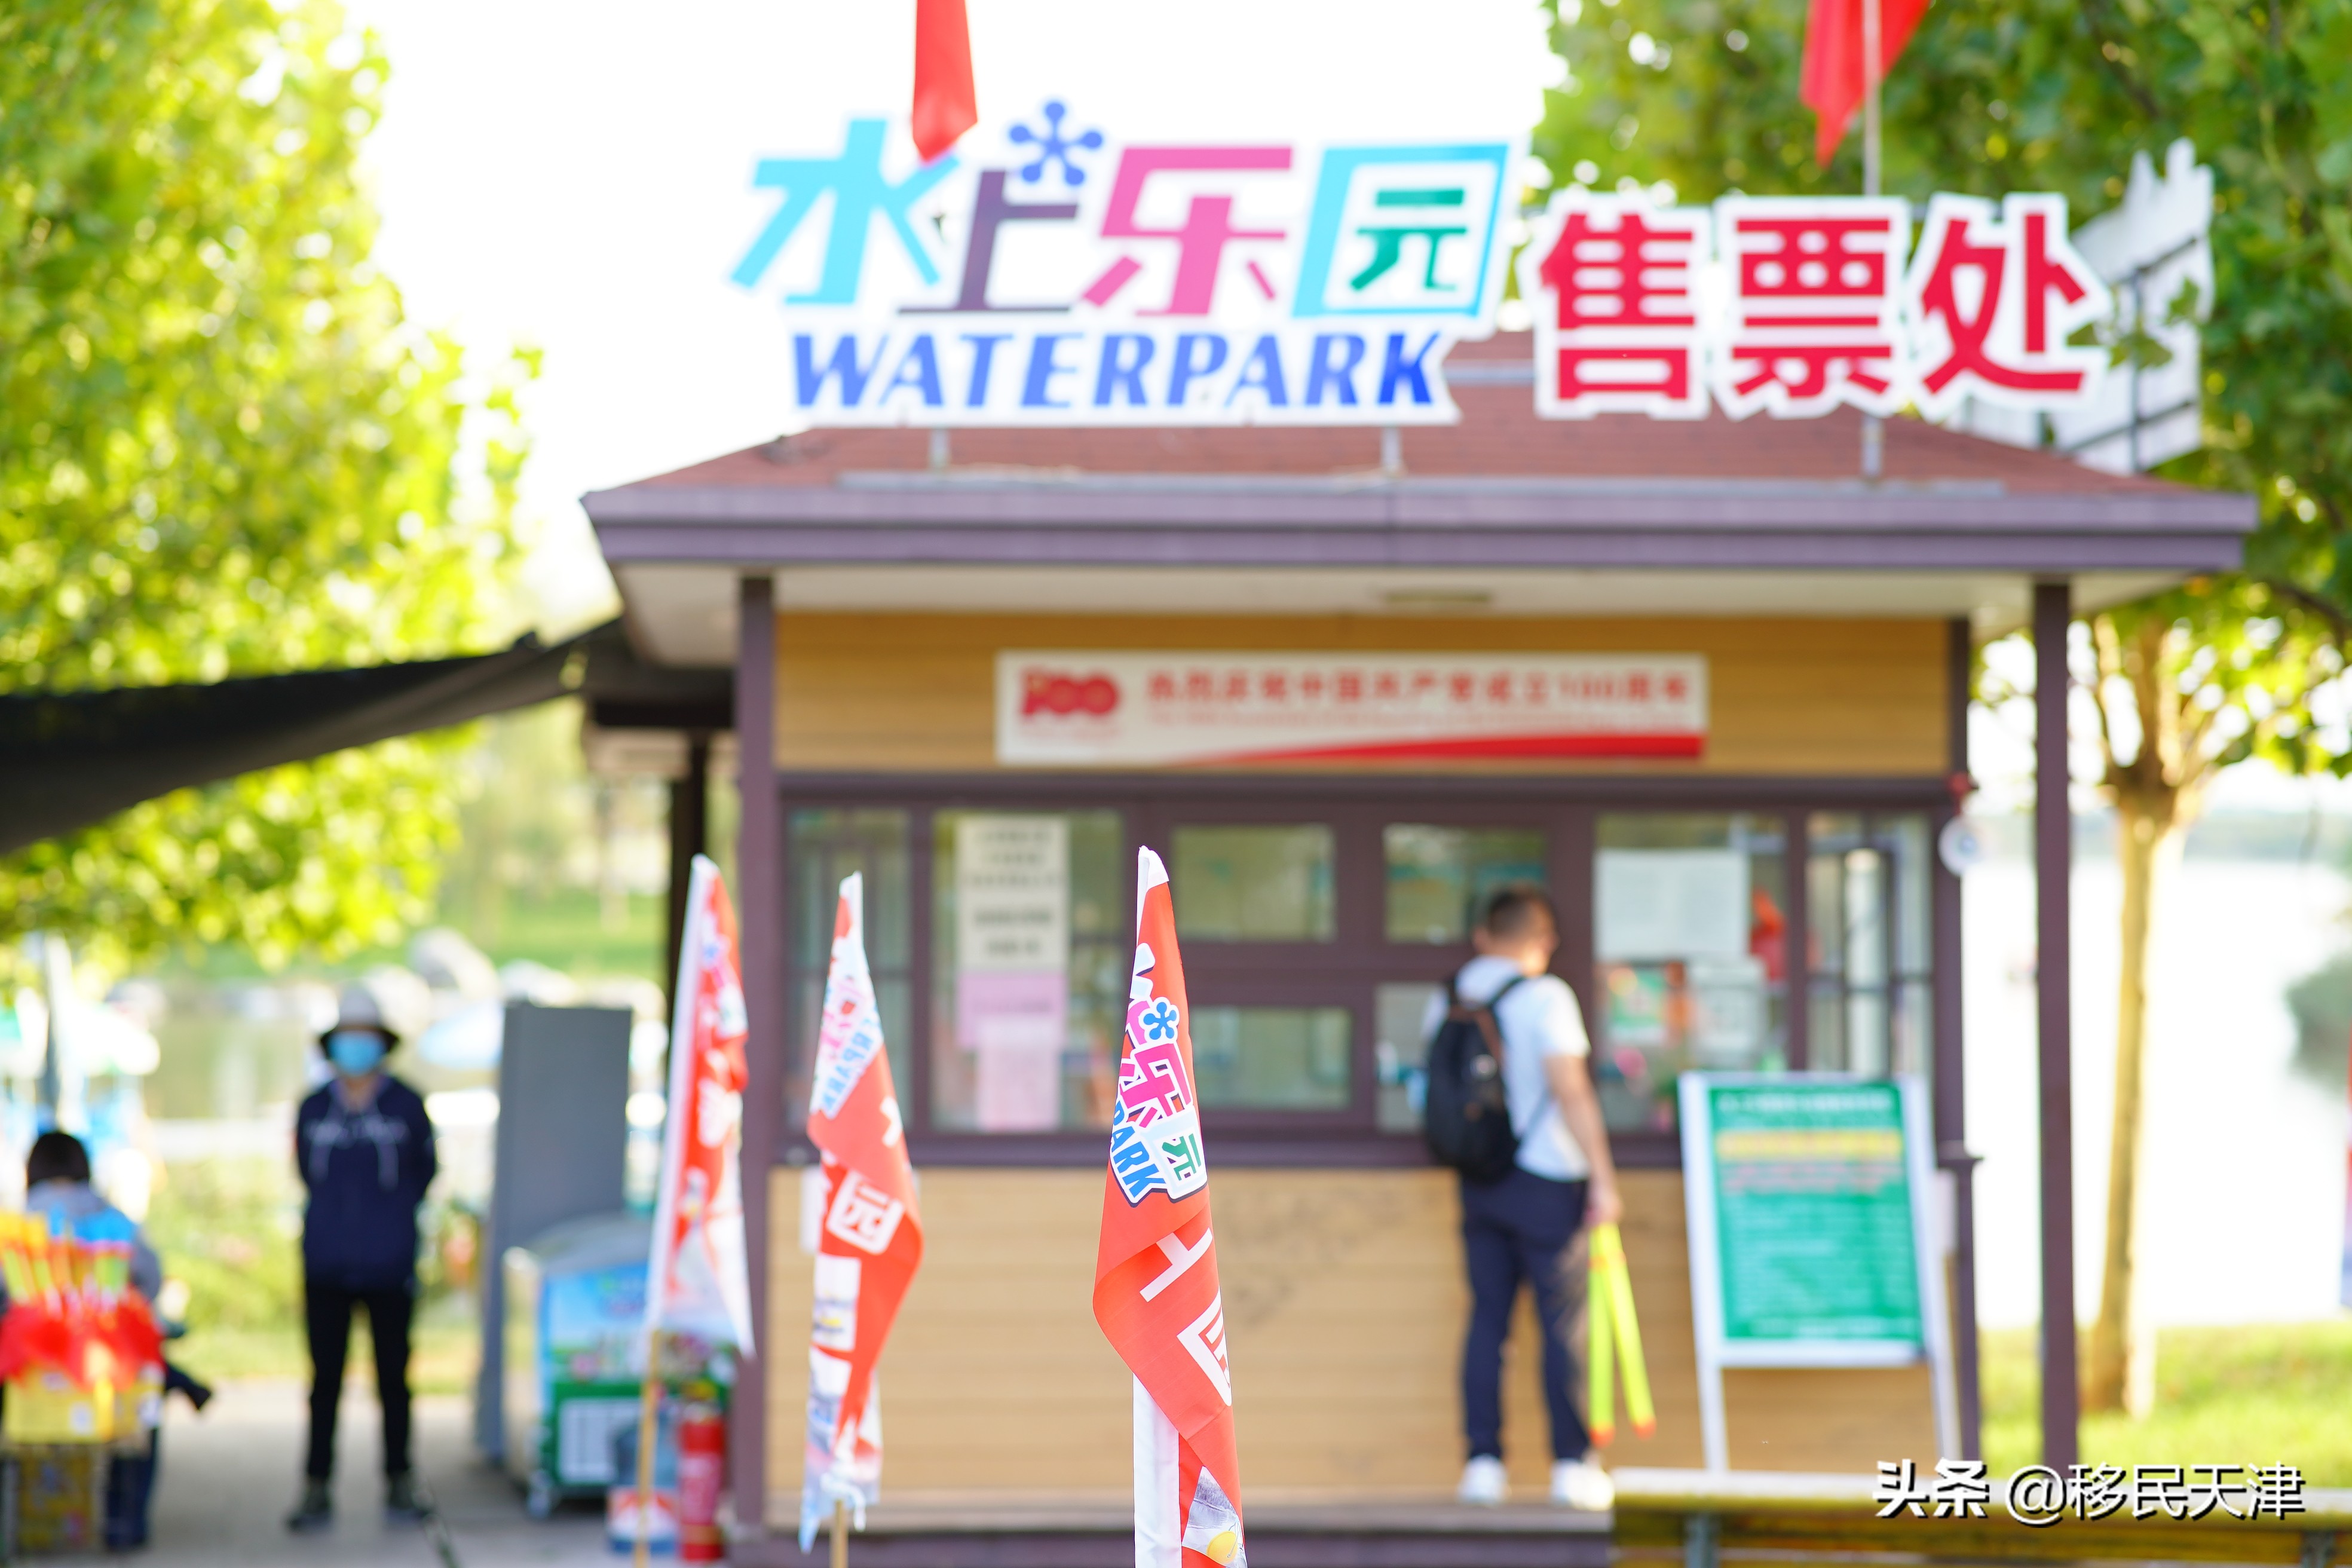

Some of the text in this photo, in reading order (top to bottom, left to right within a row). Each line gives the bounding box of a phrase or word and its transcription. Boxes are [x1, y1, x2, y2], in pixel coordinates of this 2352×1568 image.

[730, 117, 1509, 319] 水上乐园
[1539, 212, 2088, 401] 售票处
[790, 332, 1443, 409] WATERPARK
